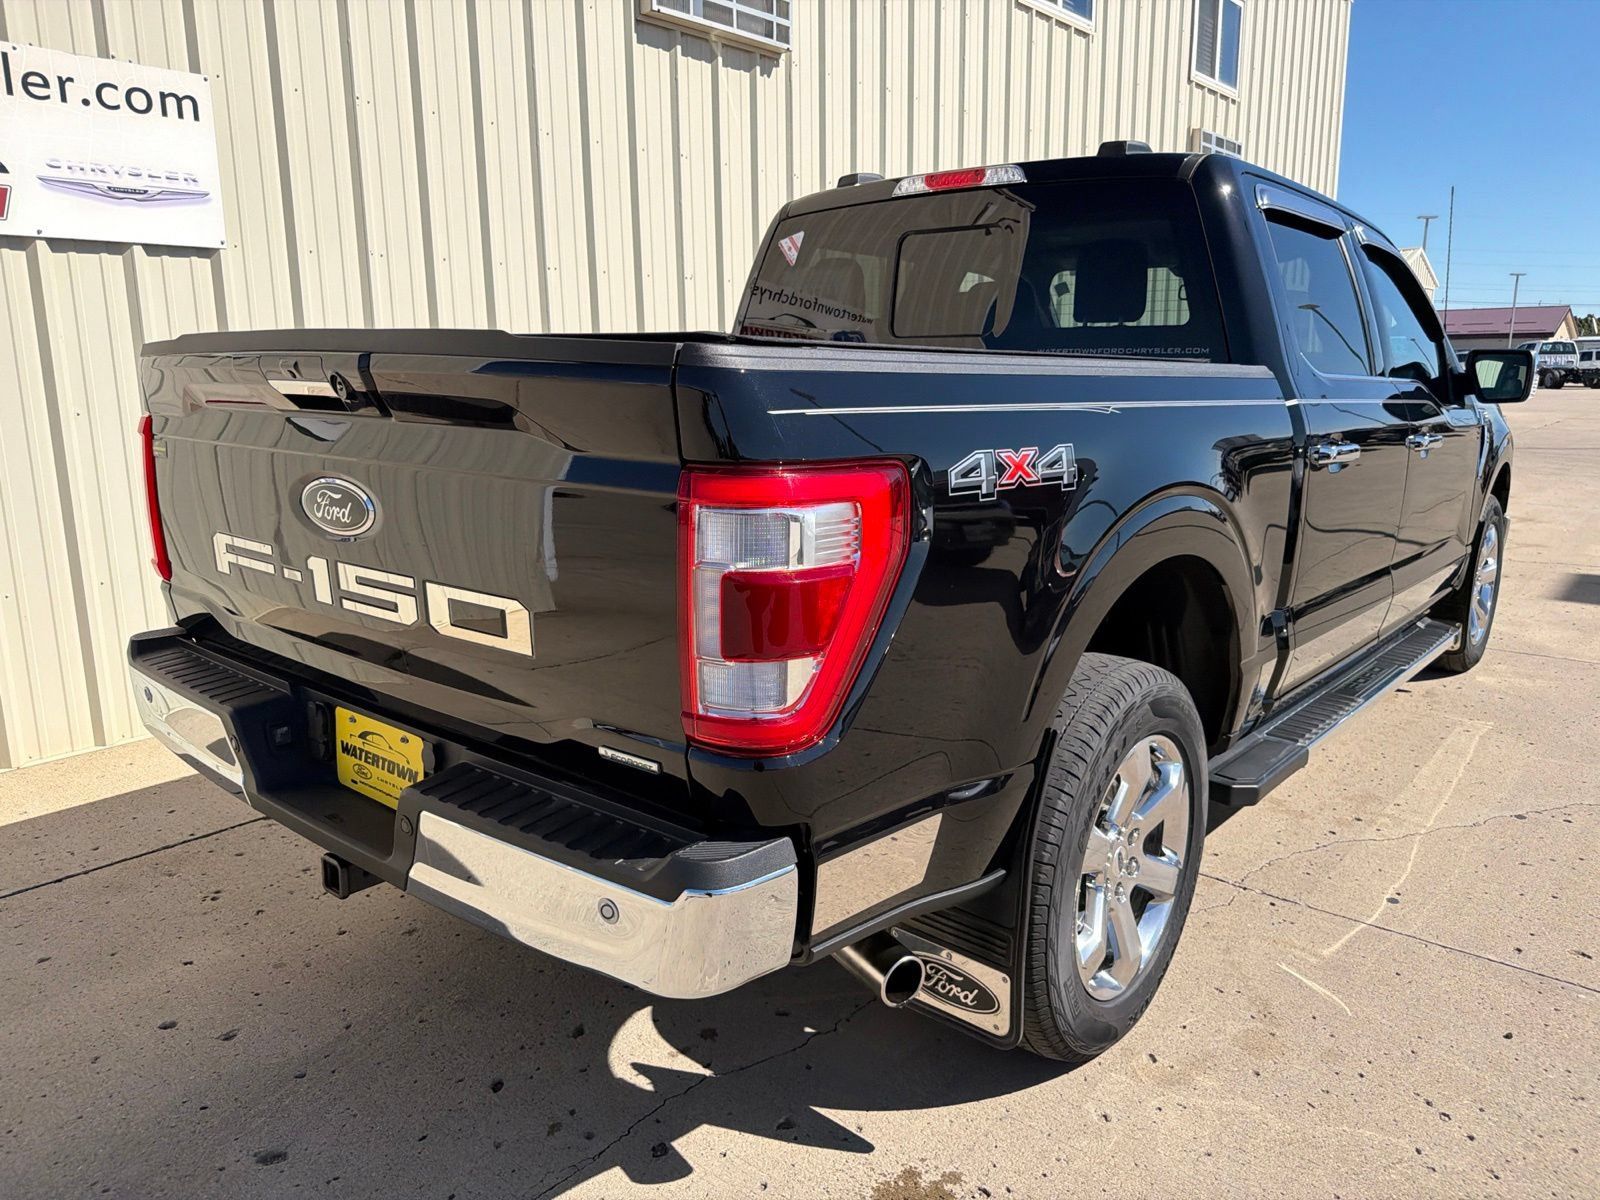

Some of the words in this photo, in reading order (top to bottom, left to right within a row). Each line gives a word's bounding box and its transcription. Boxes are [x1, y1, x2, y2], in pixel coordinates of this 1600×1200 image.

[46, 158, 199, 183] CHRYSLER
[313, 489, 353, 524] Ford
[212, 532, 535, 657] F-150
[340, 740, 419, 786] WATERTOWN
[924, 963, 979, 1006] Ford
